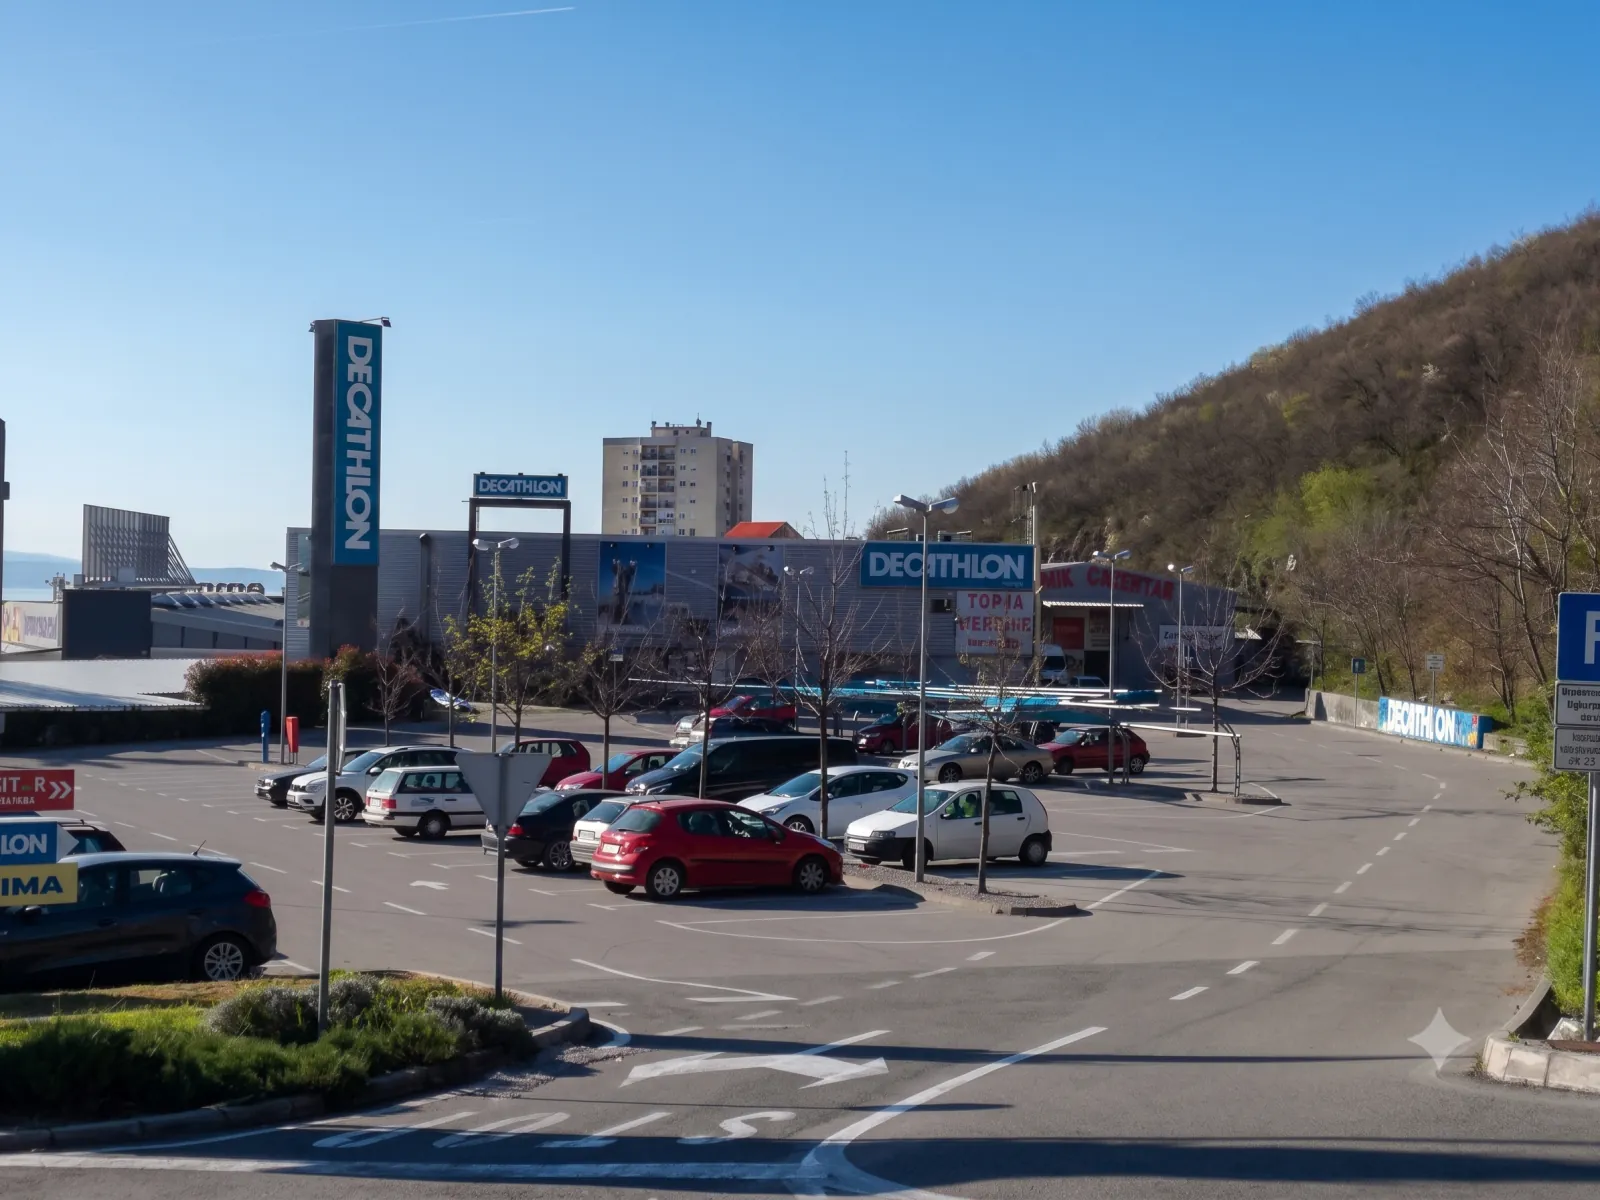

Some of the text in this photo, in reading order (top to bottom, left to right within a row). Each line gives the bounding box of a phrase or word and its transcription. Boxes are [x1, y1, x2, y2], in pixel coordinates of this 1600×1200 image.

[345, 335, 373, 550] DECATHLON
[479, 478, 562, 494] DECATHLON
[869, 551, 1025, 580] DECATHLON
